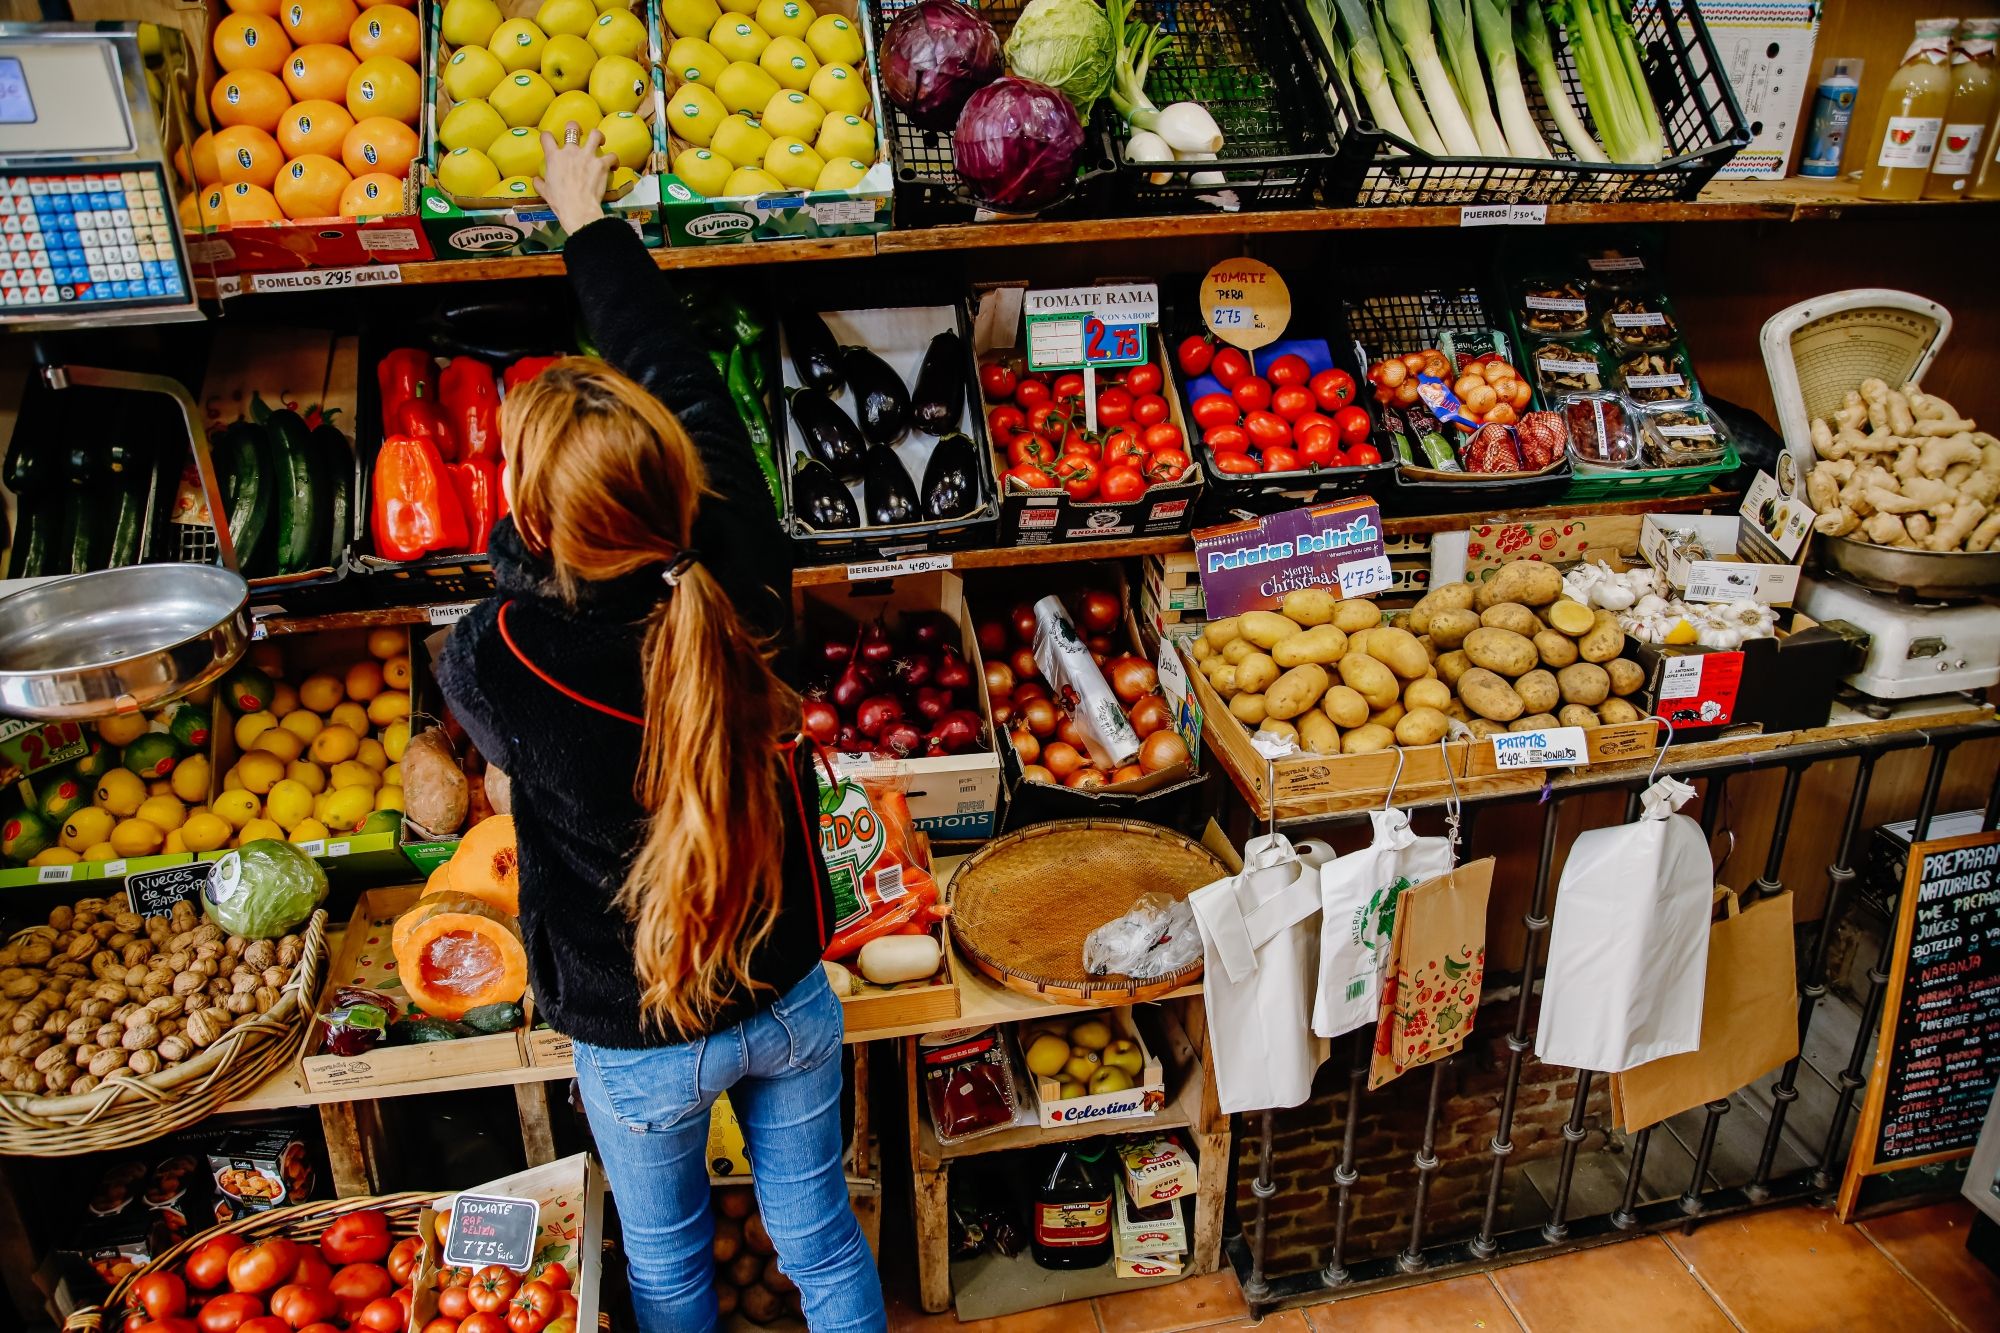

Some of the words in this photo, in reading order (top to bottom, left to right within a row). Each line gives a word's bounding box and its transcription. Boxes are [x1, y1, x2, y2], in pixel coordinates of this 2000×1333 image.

[1463, 209, 1508, 219] PUERROS
[694, 218, 749, 237] Livinda
[457, 231, 514, 249] Livinda
[257, 275, 322, 289] POMELOS
[1211, 271, 1267, 284] TOMATE
[1032, 293, 1102, 309] TOMATE
[1106, 290, 1155, 305] RAMA
[1216, 289, 1244, 301] PERA
[1070, 528, 1118, 537] ANDARAX
[1207, 541, 1295, 574] Patatas
[849, 563, 904, 575] BERENJENA
[1281, 564, 1315, 579] Merry
[1260, 568, 1340, 598] Christmas
[1495, 733, 1547, 750] PATATAS
[1917, 869, 1993, 903] NATURALES
[1917, 903, 1945, 922] WE
[1969, 912, 1987, 926] AT
[1912, 936, 1963, 959] BOTELLA
[1921, 955, 1982, 983] NARANJA
[1922, 973, 1959, 989] ORANGE
[1914, 1045, 1939, 1058] BEET
[461, 1201, 513, 1215] TOMATE
